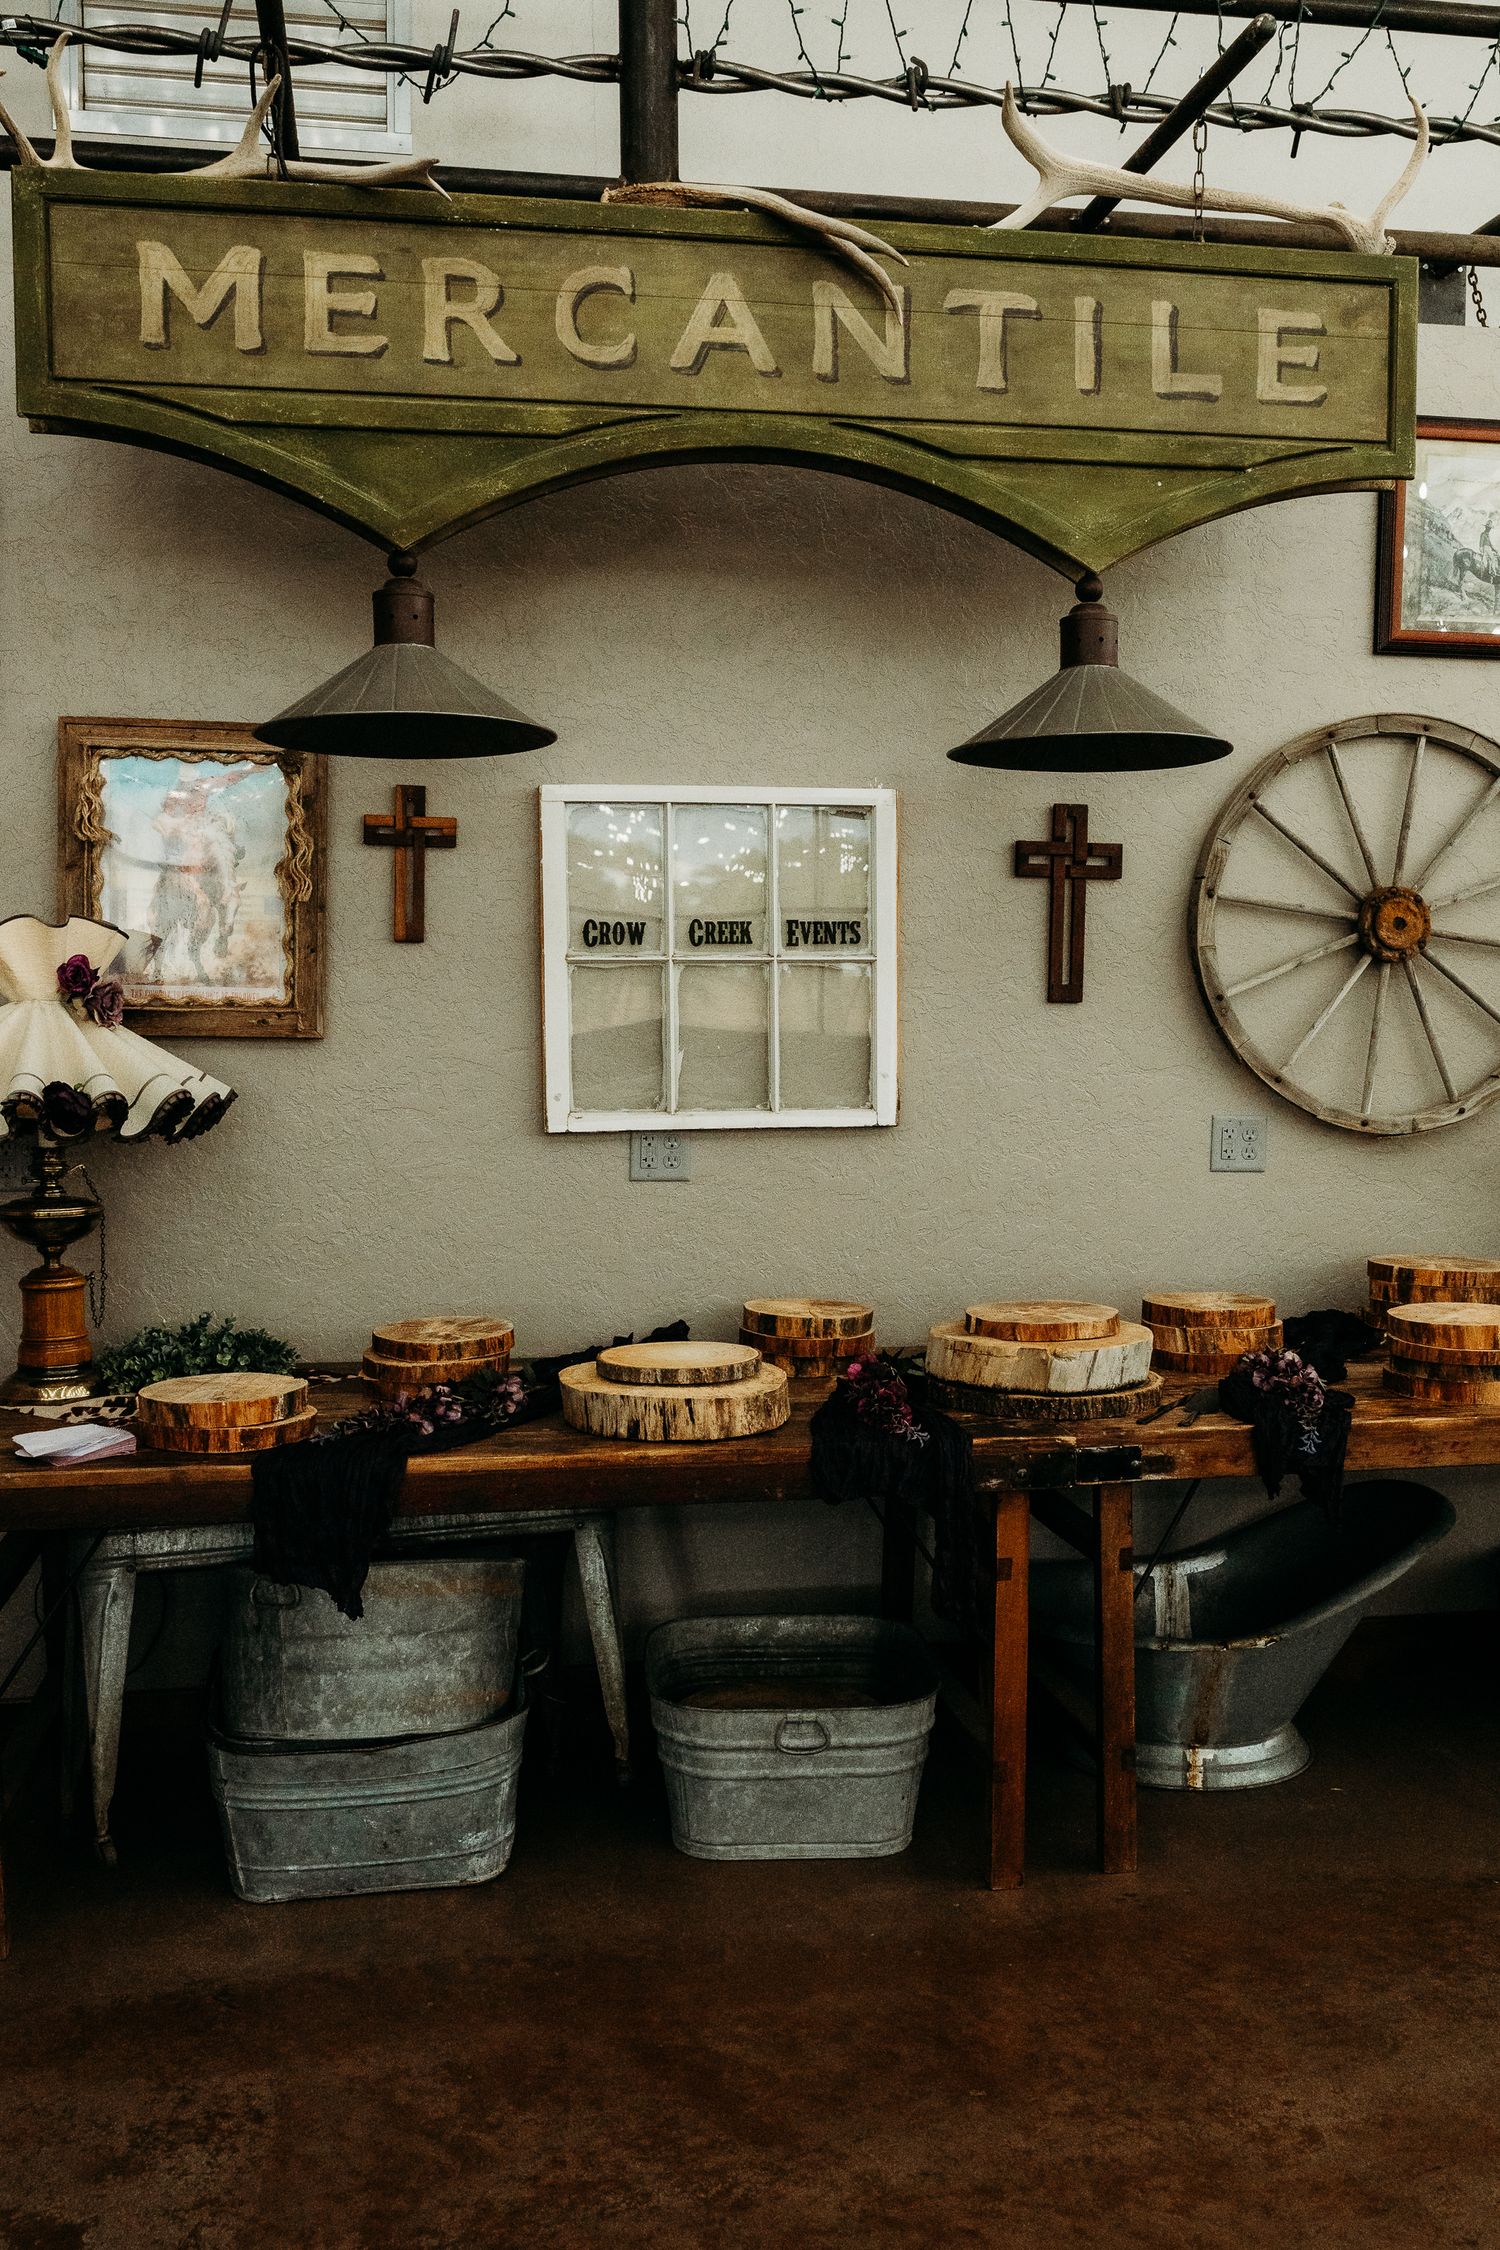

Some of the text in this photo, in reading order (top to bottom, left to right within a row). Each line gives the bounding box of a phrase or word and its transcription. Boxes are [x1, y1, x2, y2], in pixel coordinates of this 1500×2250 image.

[136, 240, 1328, 406] MERCANTILE
[582, 918, 862, 948] CROW CREEK EVENTS
